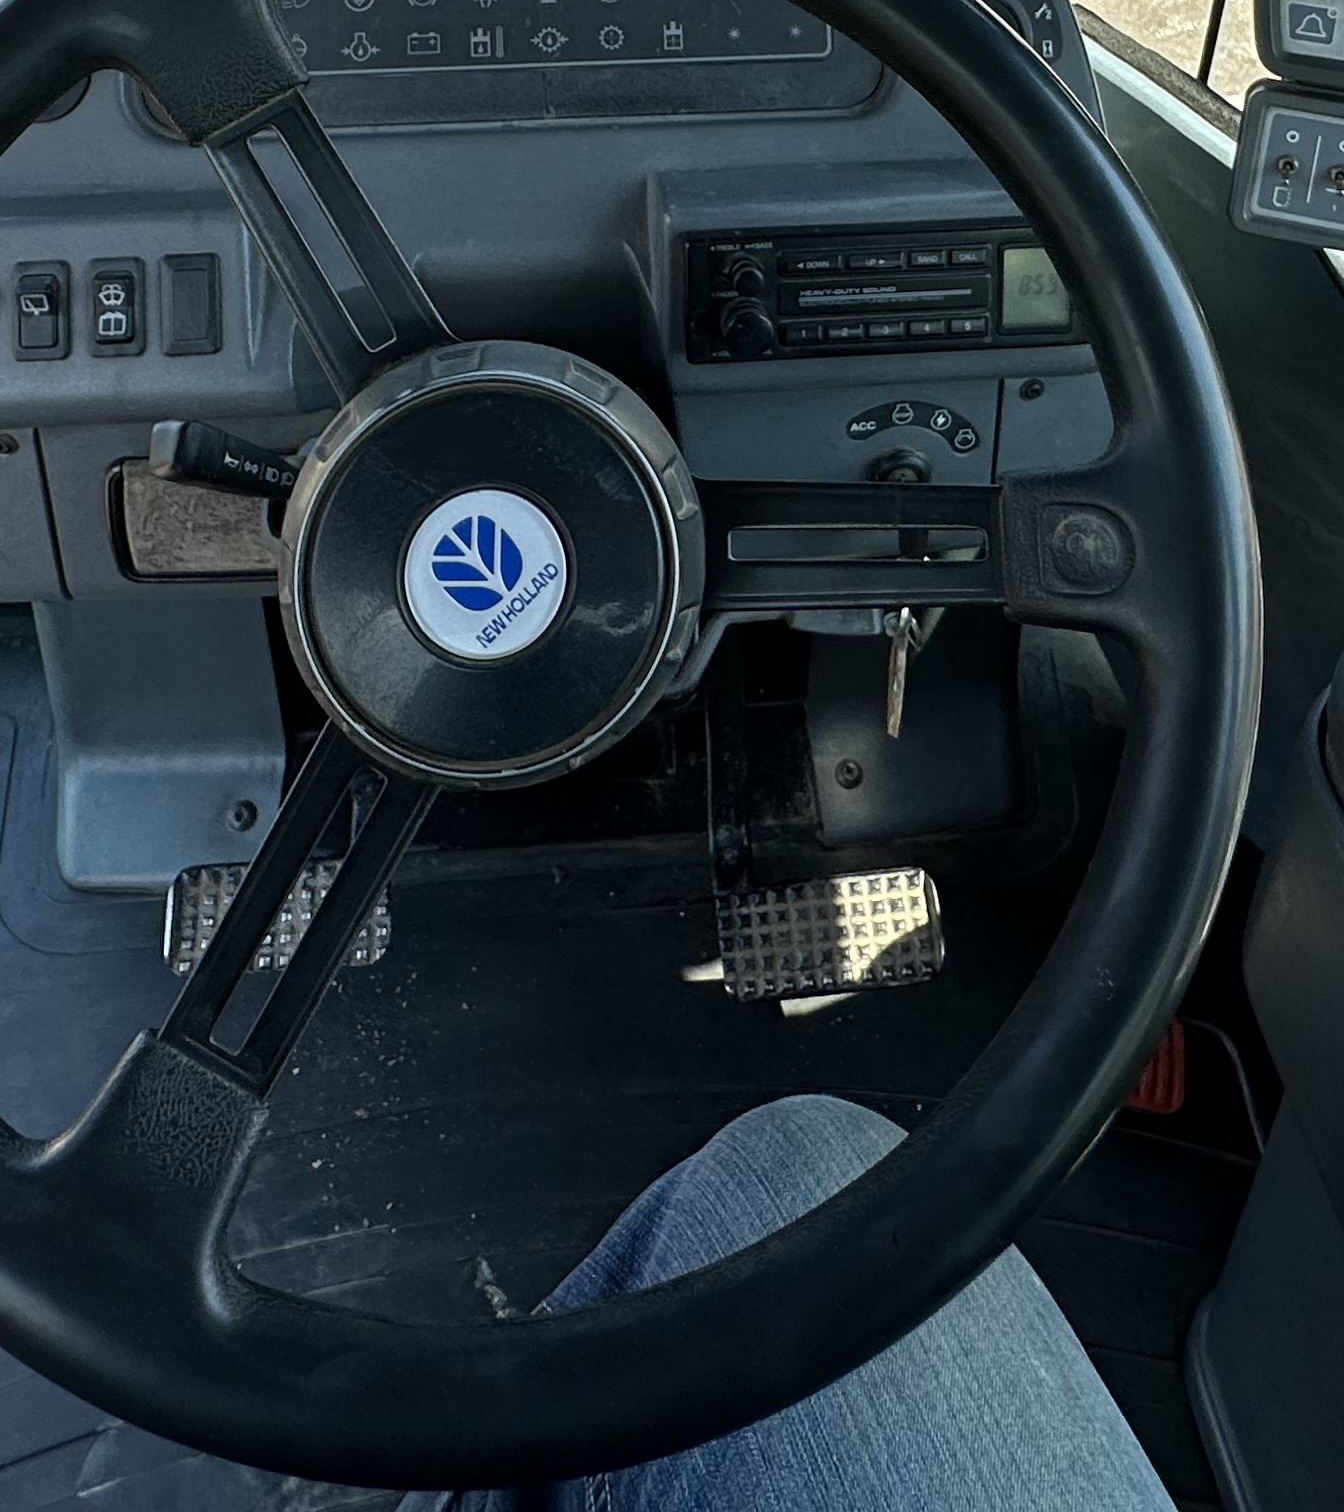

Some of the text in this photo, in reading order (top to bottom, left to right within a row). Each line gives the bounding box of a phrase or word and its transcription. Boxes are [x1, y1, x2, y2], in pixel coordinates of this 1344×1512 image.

[806, 260, 830, 269] DOWN
[800, 288, 860, 296] HEAVY-DUTY
[850, 421, 877, 432] ACC
[476, 563, 559, 649] NEW HOLLAND
